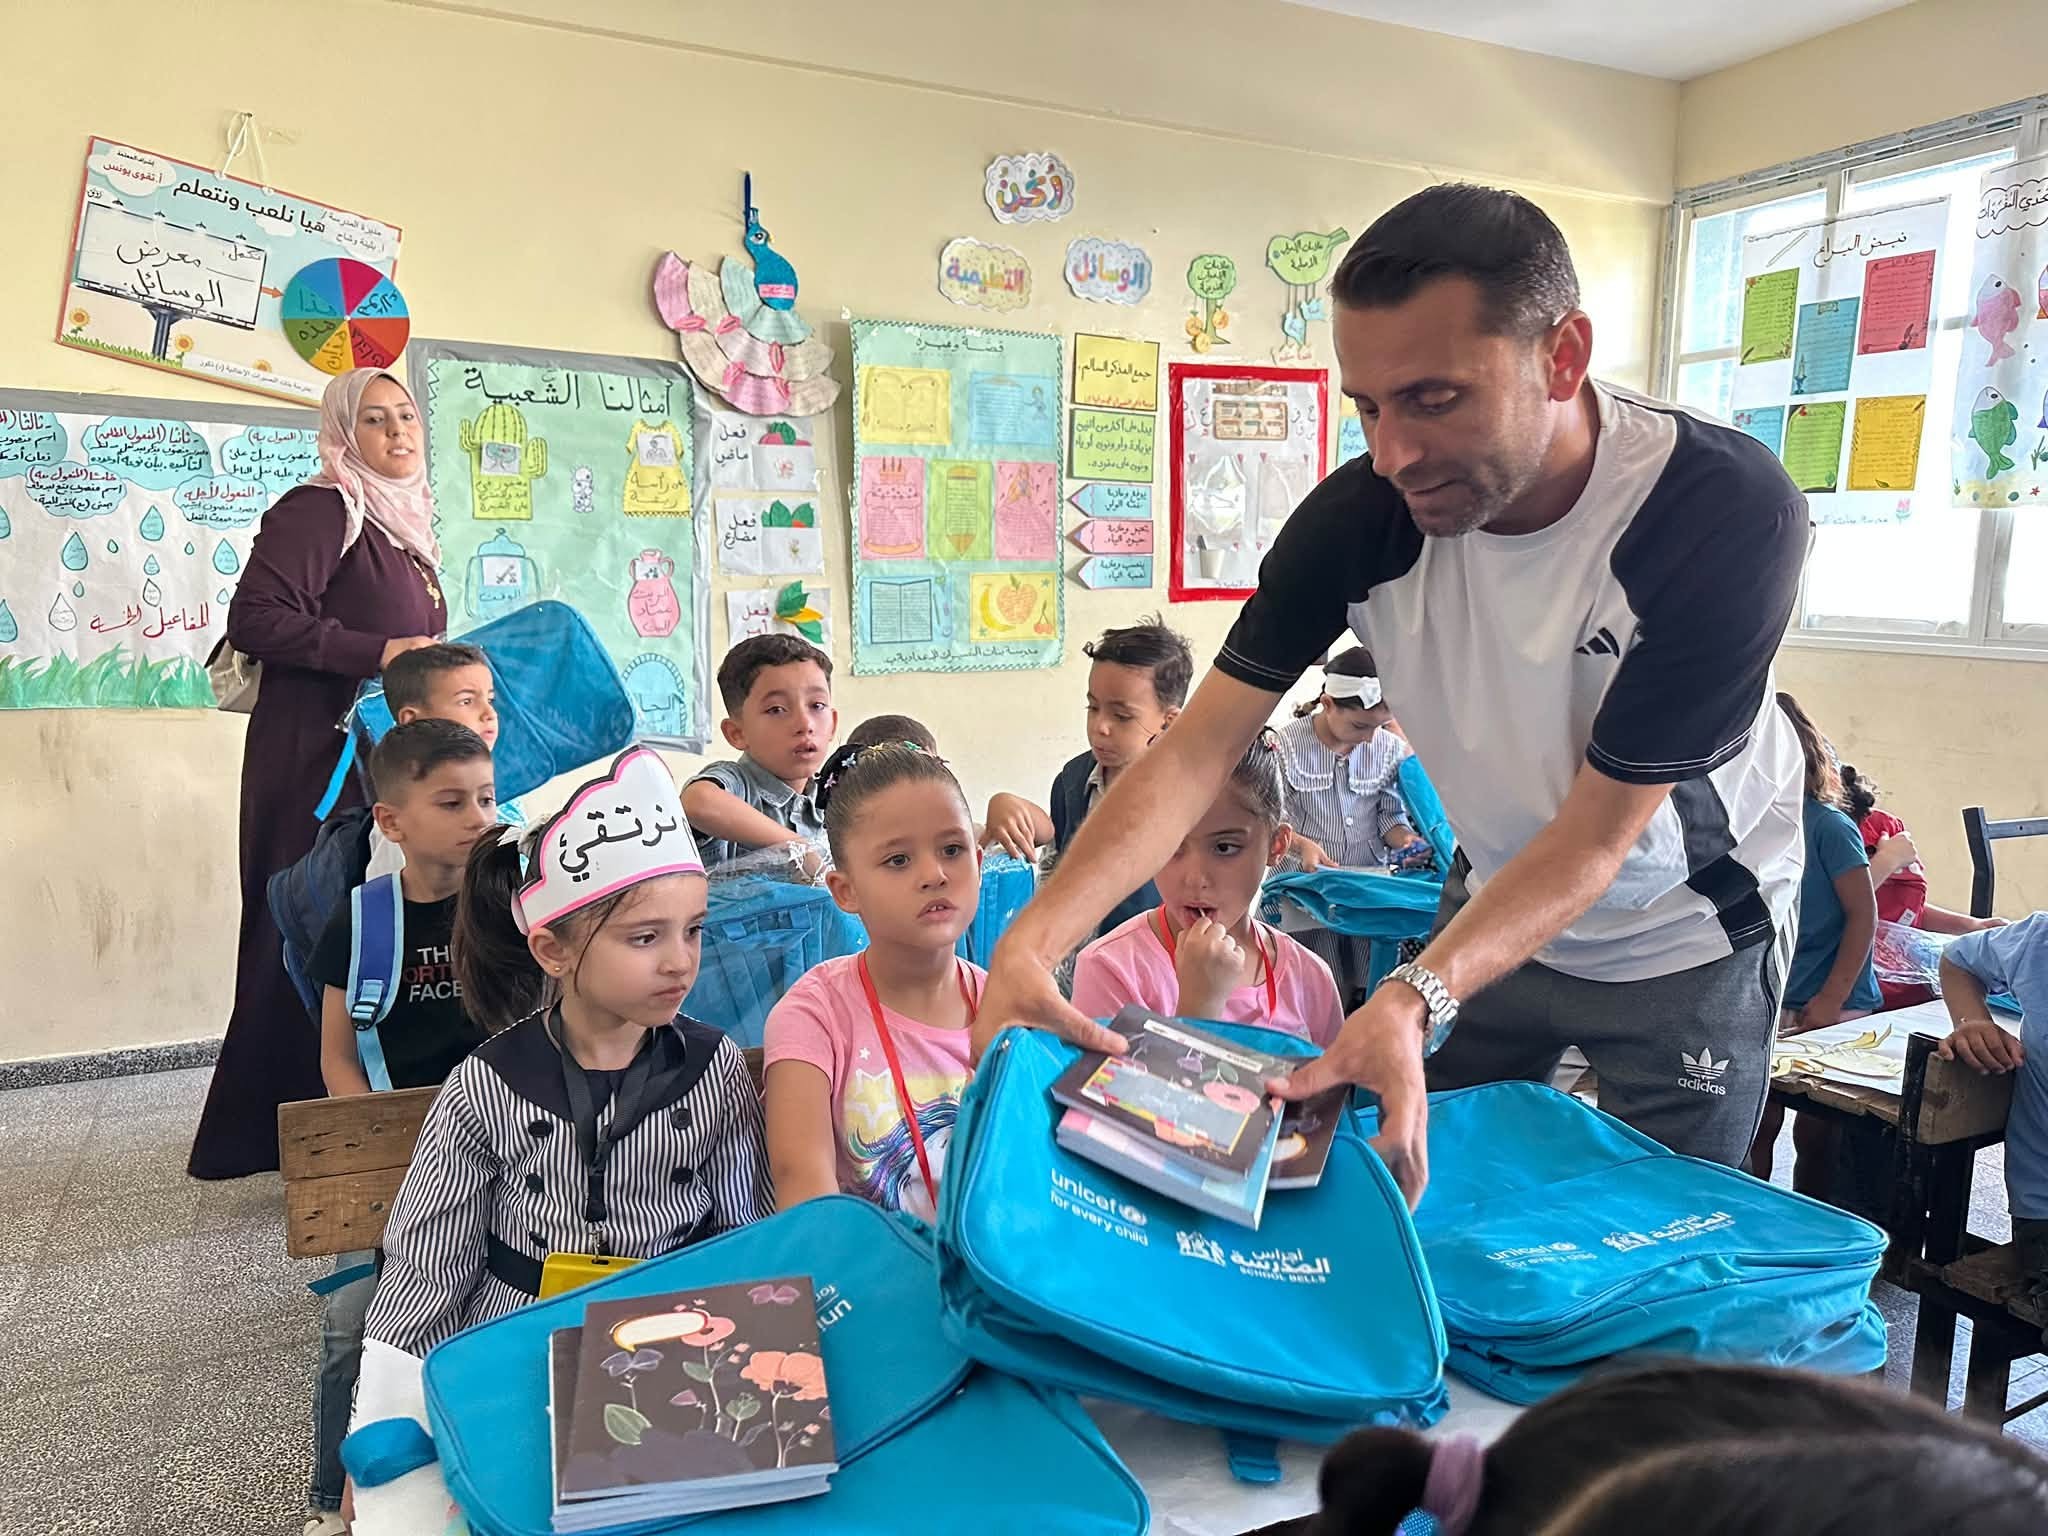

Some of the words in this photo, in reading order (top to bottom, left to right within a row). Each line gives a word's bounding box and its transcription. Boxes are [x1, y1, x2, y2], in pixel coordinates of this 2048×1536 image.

[173, 179, 240, 211] ونتعلم
[245, 201, 294, 223] نلعب
[300, 210, 326, 233] هيا
[116, 240, 201, 268] معرض
[1860, 231, 1908, 256] نبض
[1072, 250, 1145, 292] الوسائل
[719, 423, 747, 442] فعل
[729, 512, 757, 531] فعل
[724, 529, 757, 550] مضارع
[143, 601, 210, 638] المفاعيل
[743, 604, 770, 621] فعل
[417, 944, 450, 965] TH
[409, 979, 464, 1003] FACE
[1677, 1077, 1727, 1096] adidas
[1051, 1167, 1118, 1216] unicef
[1050, 1189, 1070, 1211] for
[1071, 1203, 1113, 1233] every
[1114, 1224, 1149, 1247] child
[1230, 1249, 1331, 1275] المدرسة
[1486, 1243, 1551, 1261] unicef
[816, 1299, 853, 1333] uni
